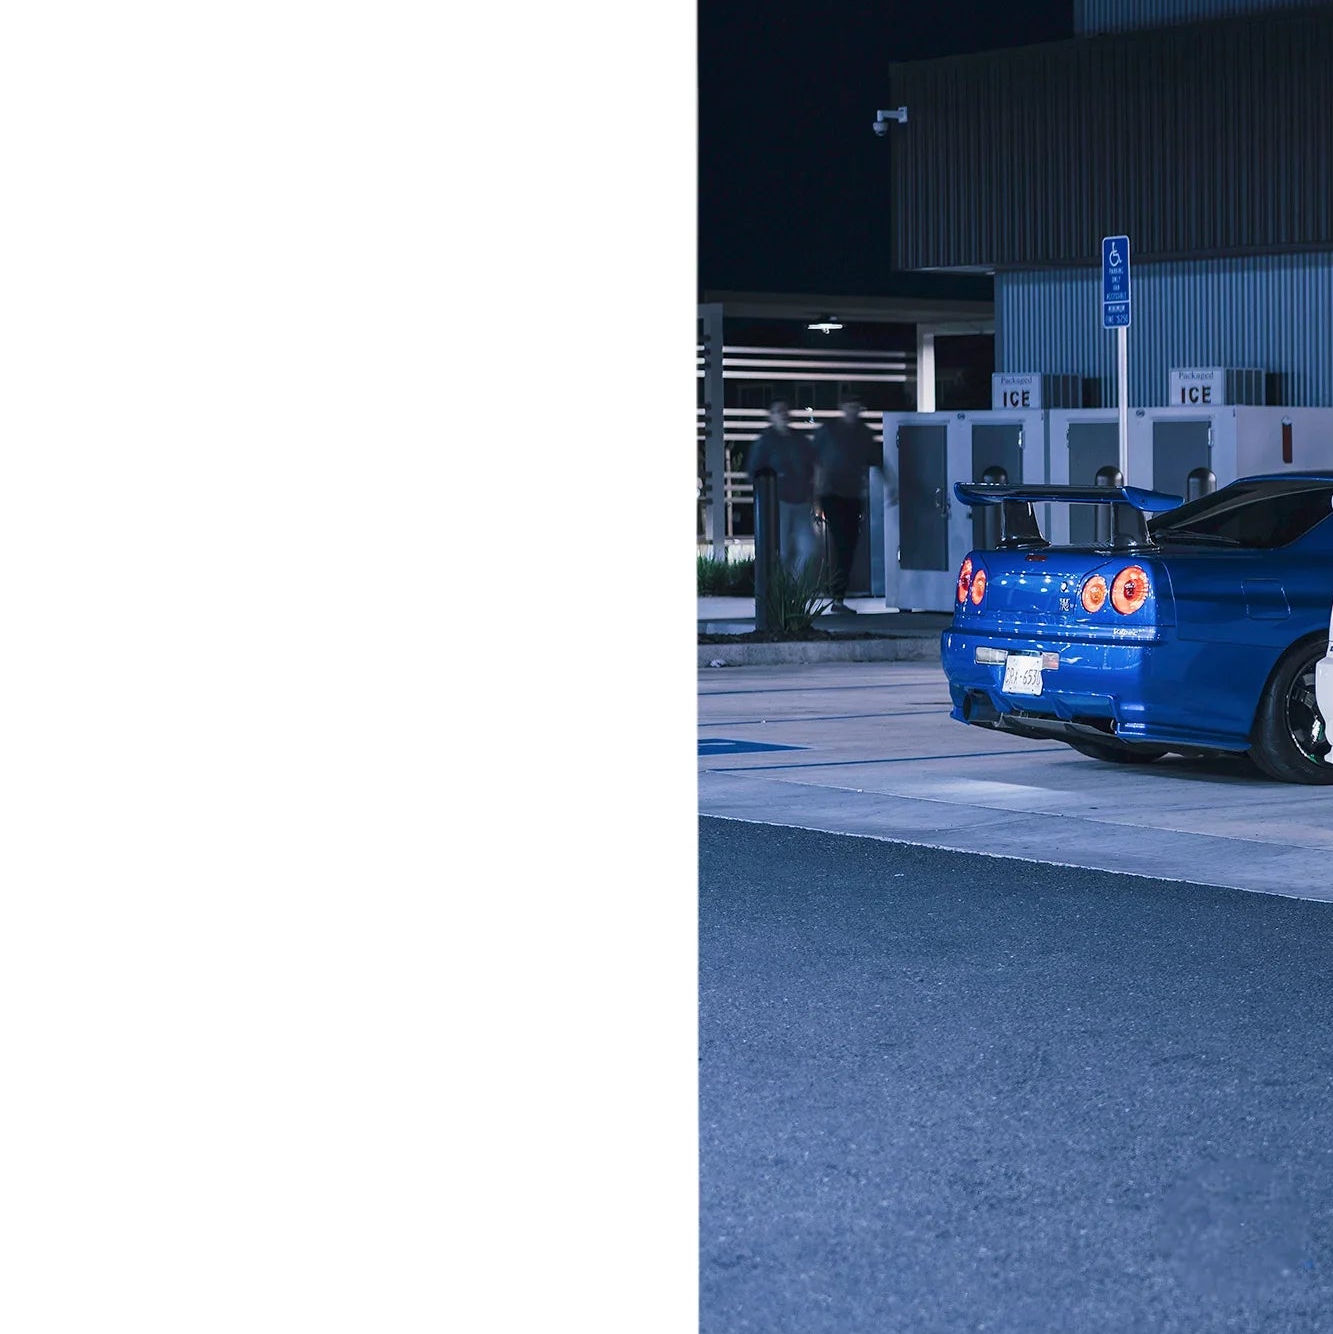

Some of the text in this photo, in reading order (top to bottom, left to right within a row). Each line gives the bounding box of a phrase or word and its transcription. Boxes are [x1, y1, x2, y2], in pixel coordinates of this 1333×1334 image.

[1000, 376, 1033, 385] Packaged
[1178, 371, 1214, 380] Packaged
[1003, 390, 1031, 408] ICE
[1181, 386, 1212, 405] ICE
